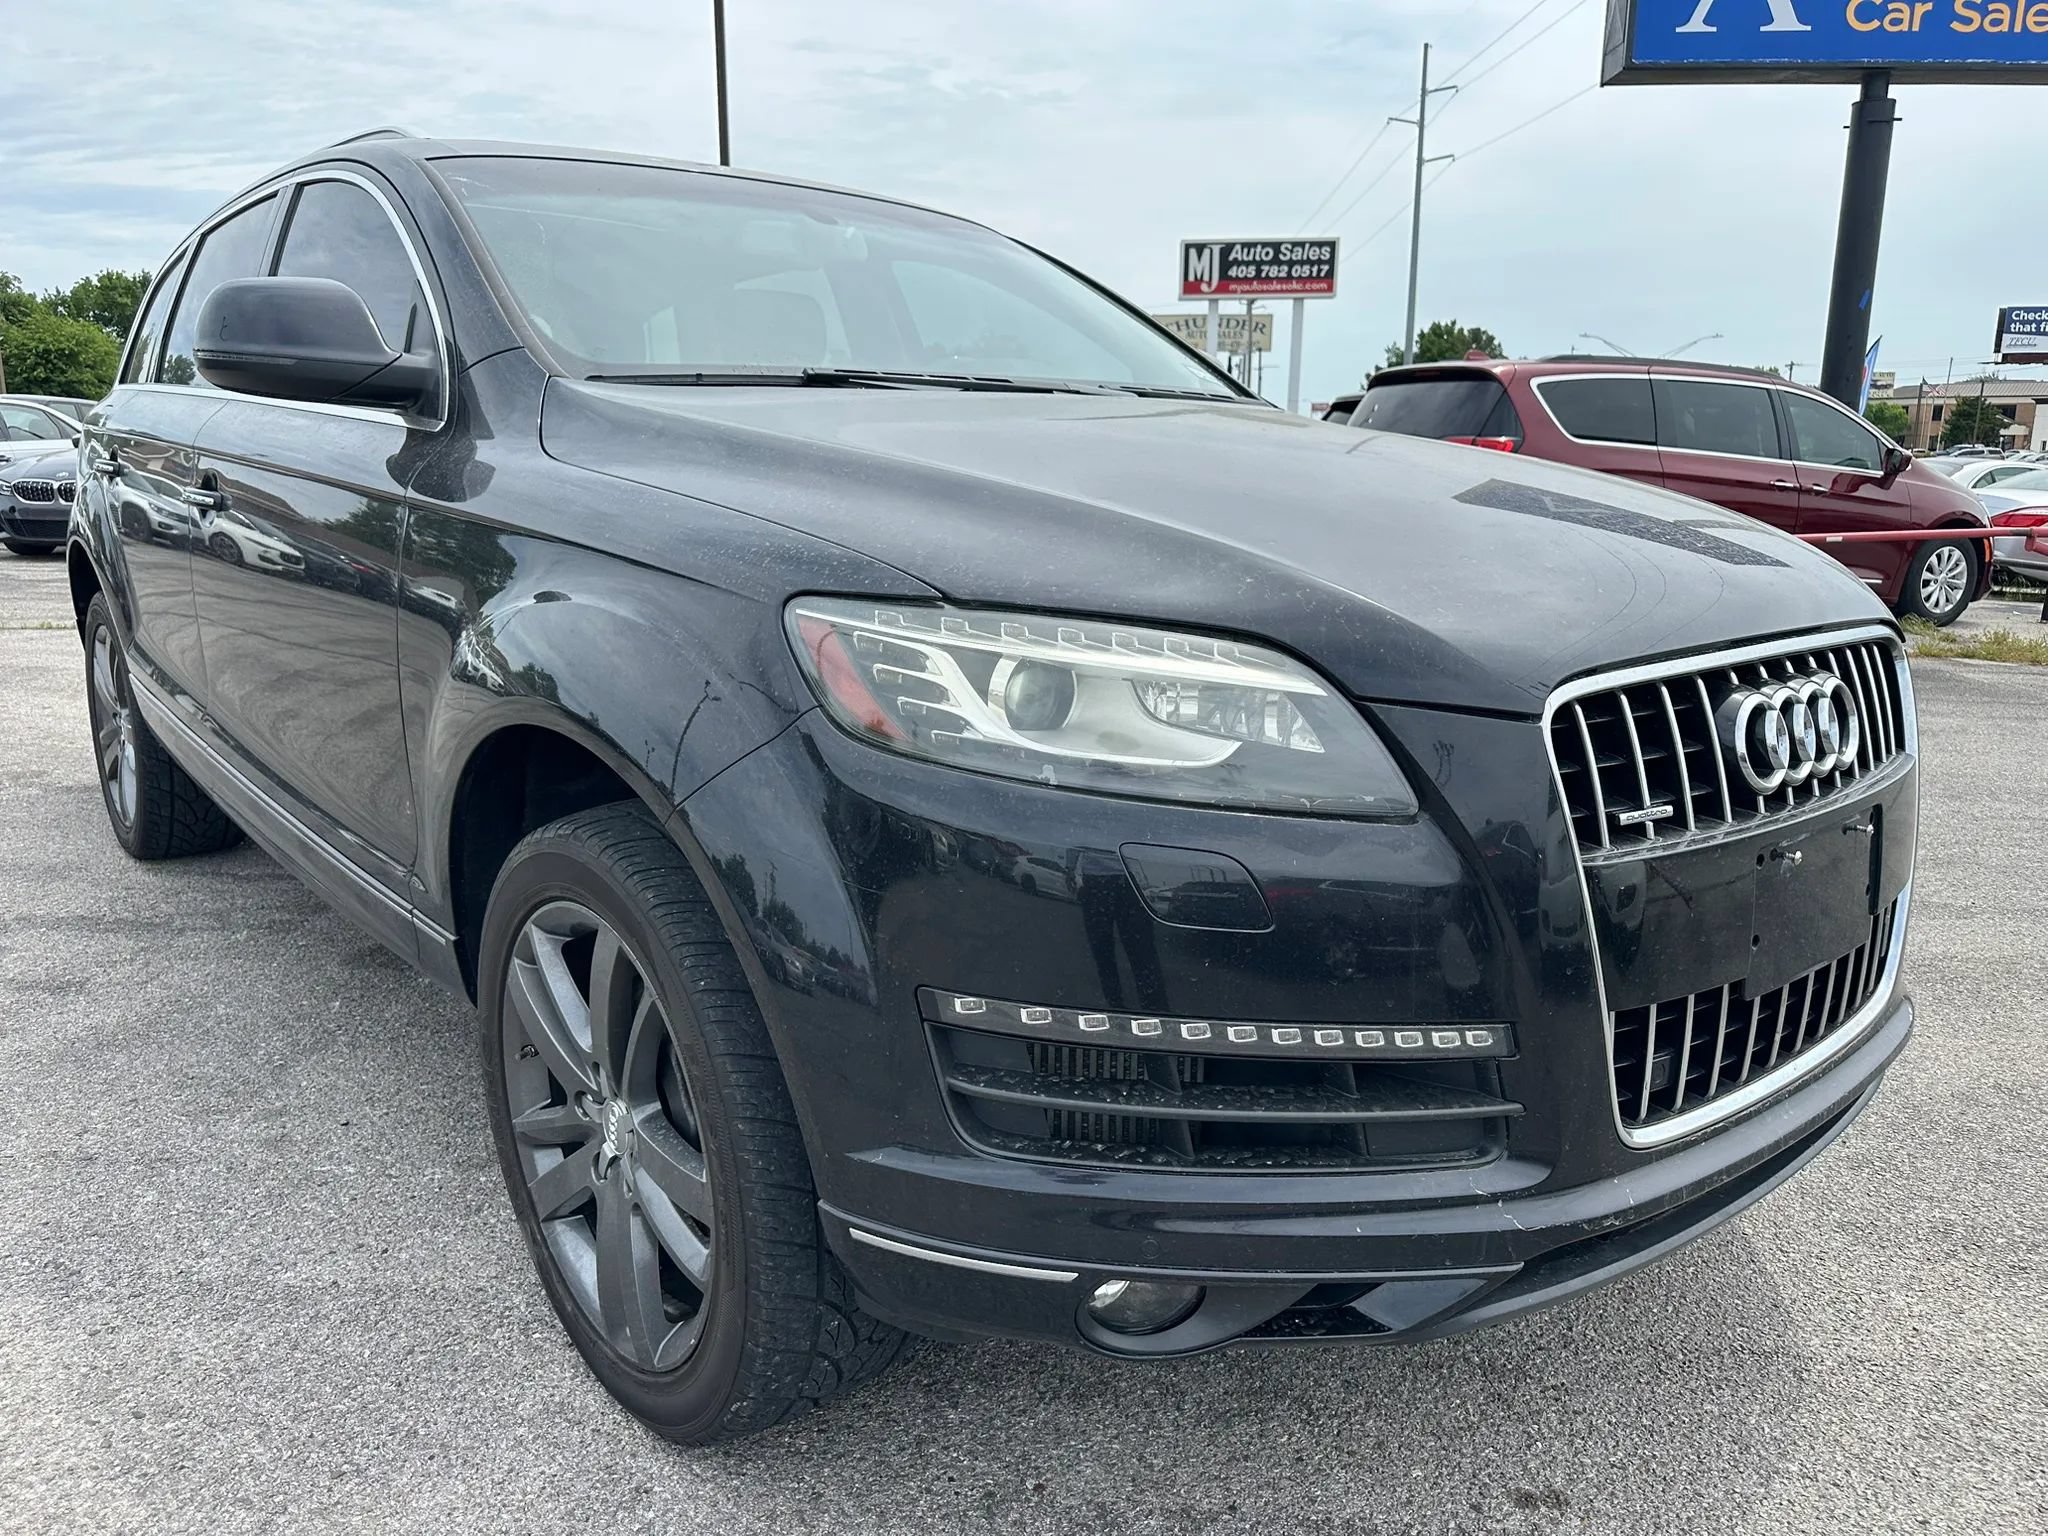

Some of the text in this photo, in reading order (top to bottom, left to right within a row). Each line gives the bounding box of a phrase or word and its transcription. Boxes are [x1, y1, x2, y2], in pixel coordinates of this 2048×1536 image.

[1846, 0, 1933, 32] Car
[1950, 0, 2048, 33] Sale
[1228, 243, 1332, 262] Auto Sales
[1188, 244, 1226, 293] MJ
[1227, 264, 1330, 278] 405 782 0517
[2010, 321, 2037, 332] that
[1626, 809, 1668, 821] quattro
